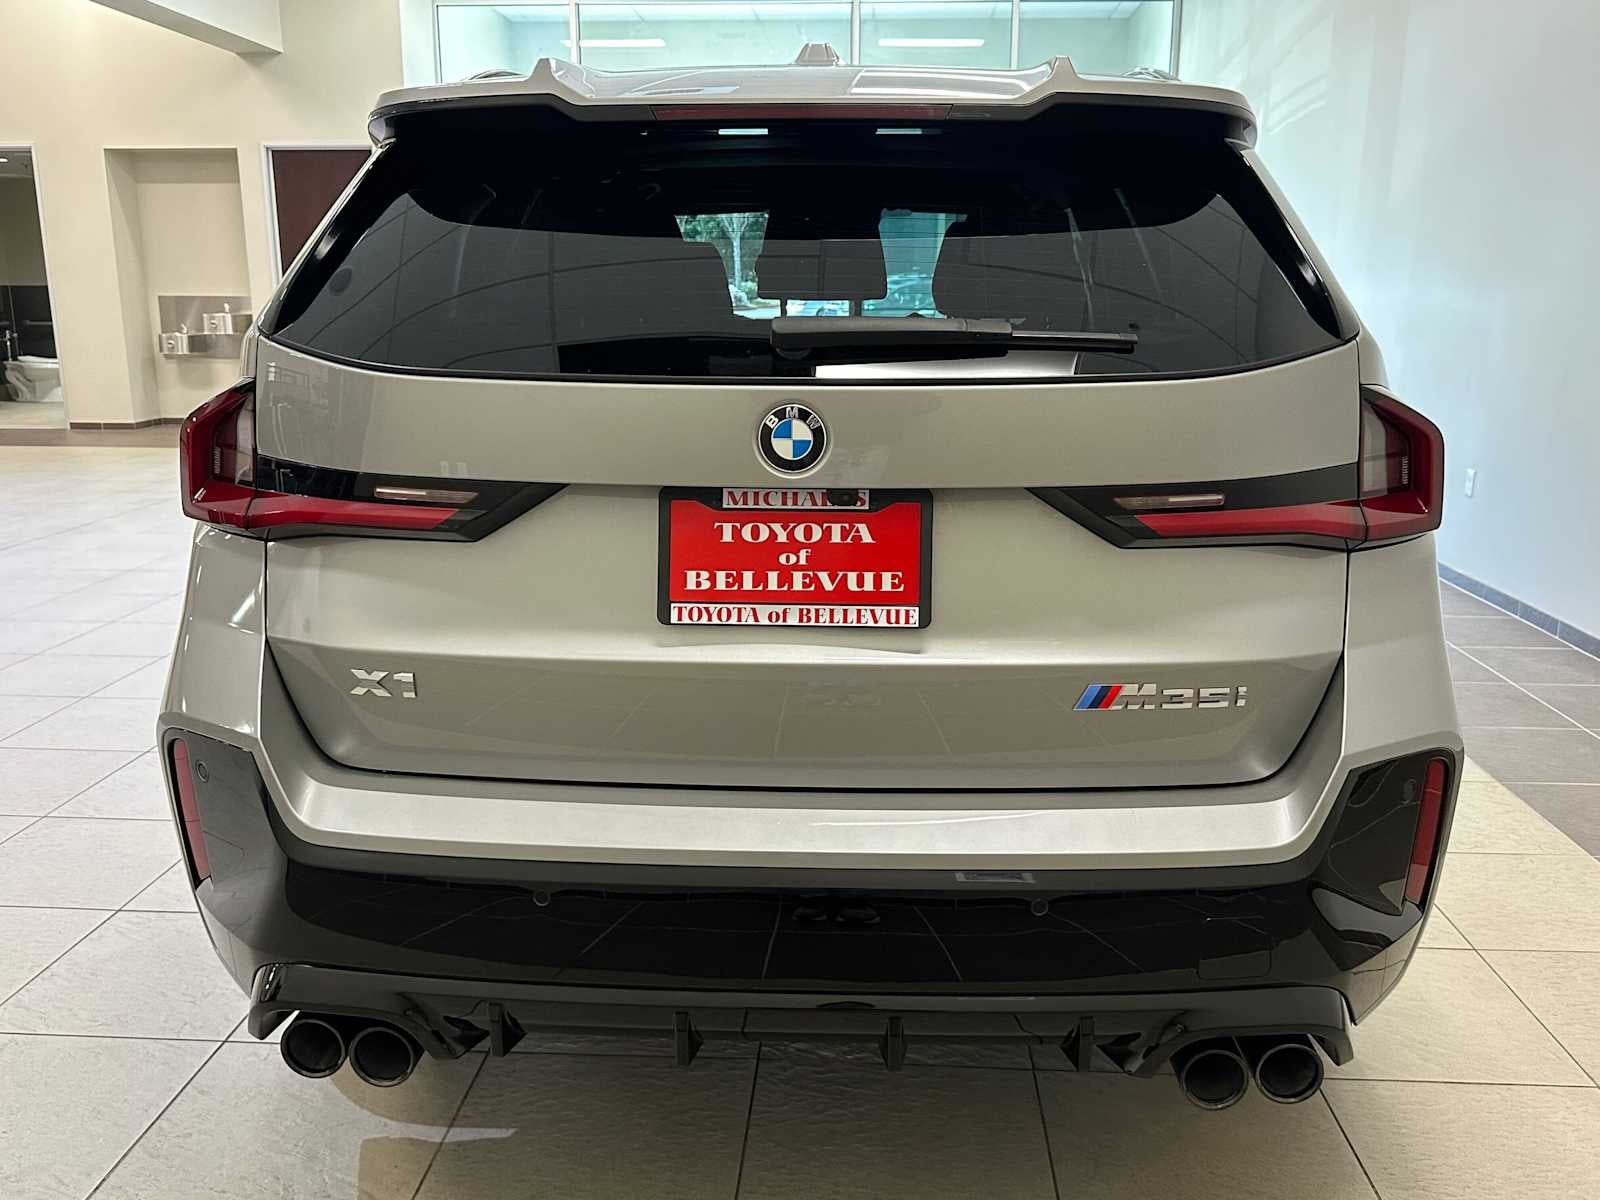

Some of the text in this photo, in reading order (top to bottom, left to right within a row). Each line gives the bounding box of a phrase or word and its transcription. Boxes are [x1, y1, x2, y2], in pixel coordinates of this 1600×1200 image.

[765, 406, 821, 429] BMW
[714, 522, 876, 544] TOYOTA
[778, 549, 811, 566] of
[683, 570, 905, 592] BELLEVUE
[673, 606, 918, 626] TOYOTA of BELLEVUE
[350, 668, 418, 698] X1
[1104, 683, 1248, 711] M35i
